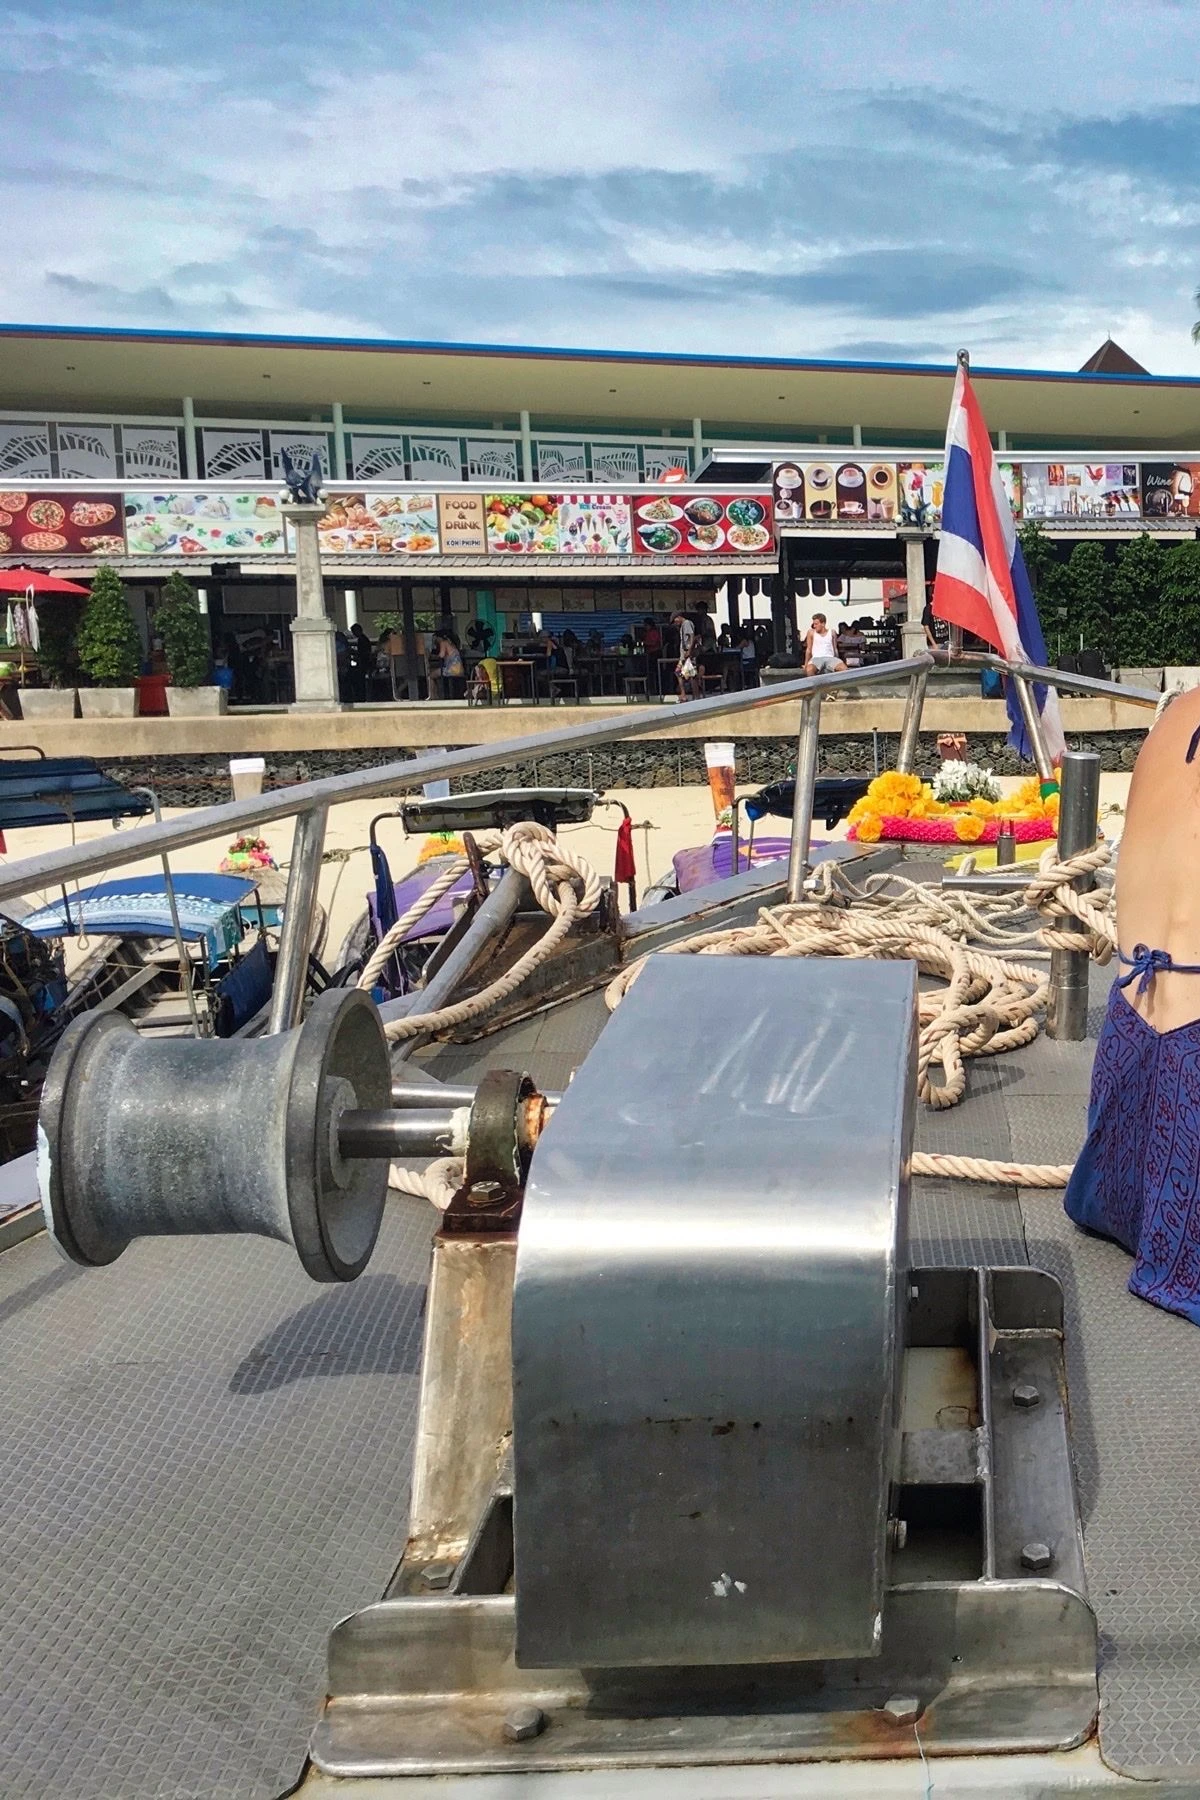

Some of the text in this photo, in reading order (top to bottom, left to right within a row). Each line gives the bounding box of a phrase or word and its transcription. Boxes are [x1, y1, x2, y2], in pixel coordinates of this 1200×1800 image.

[1146, 474, 1173, 487] Wine
[445, 500, 477, 511] FOOD
[445, 520, 481, 531] DRINK
